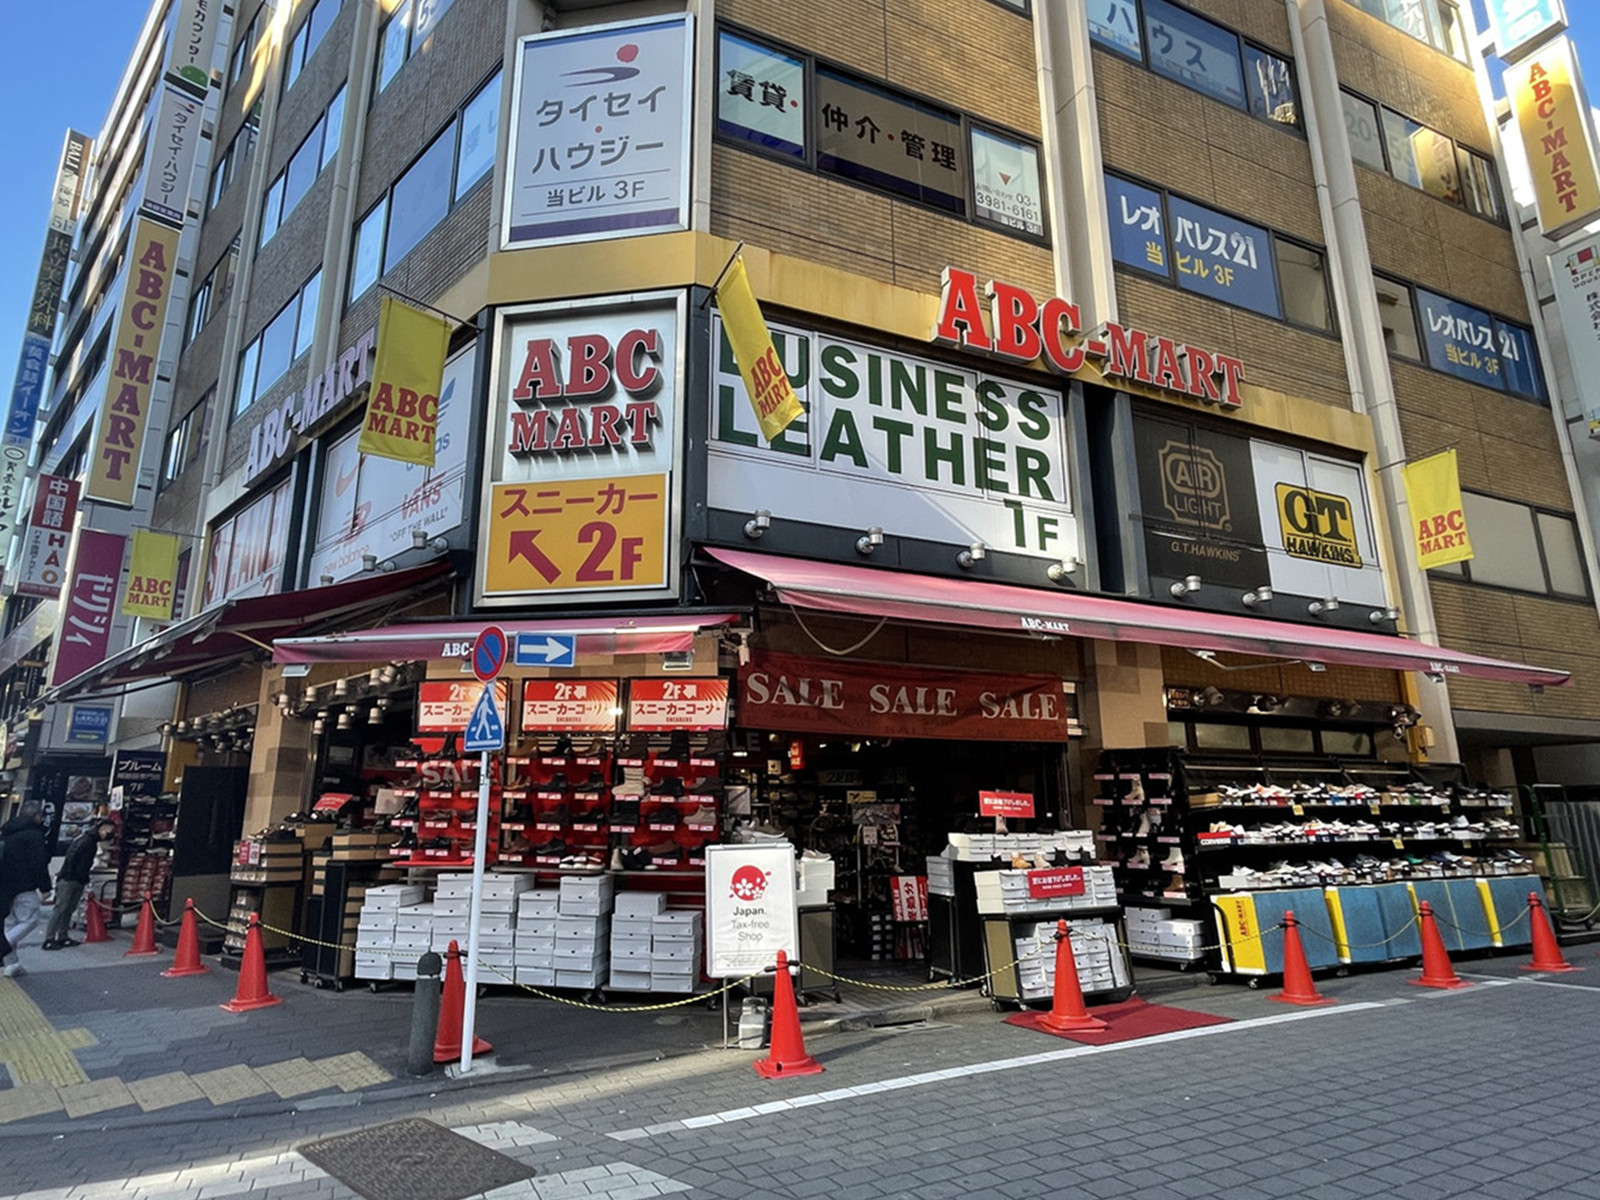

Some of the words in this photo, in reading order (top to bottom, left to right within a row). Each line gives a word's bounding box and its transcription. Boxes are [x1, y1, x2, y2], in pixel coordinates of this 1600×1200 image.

[536, 86, 666, 127] タイセイ
[1529, 62, 1578, 213] ABC-MART
[532, 136, 664, 174] ハウジー
[547, 185, 606, 208] 当ビル
[614, 180, 645, 199] 3F
[976, 191, 1039, 221] 3981-6161
[1120, 195, 1258, 269] レオパレス21
[1145, 241, 1209, 279] 当ビル
[1213, 264, 1234, 287] 3F
[1574, 274, 1600, 289] HOUS
[935, 266, 1245, 411] ABC-MART
[1427, 307, 1519, 362] レオパレス21
[103, 240, 167, 480] ABC-MART
[512, 329, 660, 400] ABC
[750, 346, 782, 400] ABC
[1484, 356, 1500, 376] 3F
[242, 327, 376, 488] ABC-MART
[371, 382, 438, 422] ABC
[367, 411, 435, 444] MART
[508, 401, 660, 453] MART
[500, 482, 659, 519] スニーカー
[1174, 494, 1222, 518] LIGHT
[1284, 489, 1352, 543] GT
[1003, 498, 1059, 552] 1F
[1418, 509, 1465, 541] ABC
[575, 521, 644, 583] 2F
[1287, 536, 1355, 564] HAWKINS
[1420, 531, 1467, 557] MART
[127, 592, 170, 609] MART
[129, 576, 172, 596] ABC
[1020, 616, 1070, 633] ABC-MART
[448, 683, 468, 702] 2F
[554, 682, 572, 701] 2F
[661, 681, 682, 700] 2F
[746, 672, 845, 710] SALE
[869, 683, 958, 717] SALE
[978, 691, 1060, 721] SALE
[420, 761, 474, 785] SAL
[731, 919, 770, 930] Tax-free
[732, 906, 768, 917] Japan.
[737, 931, 763, 943] Shop
